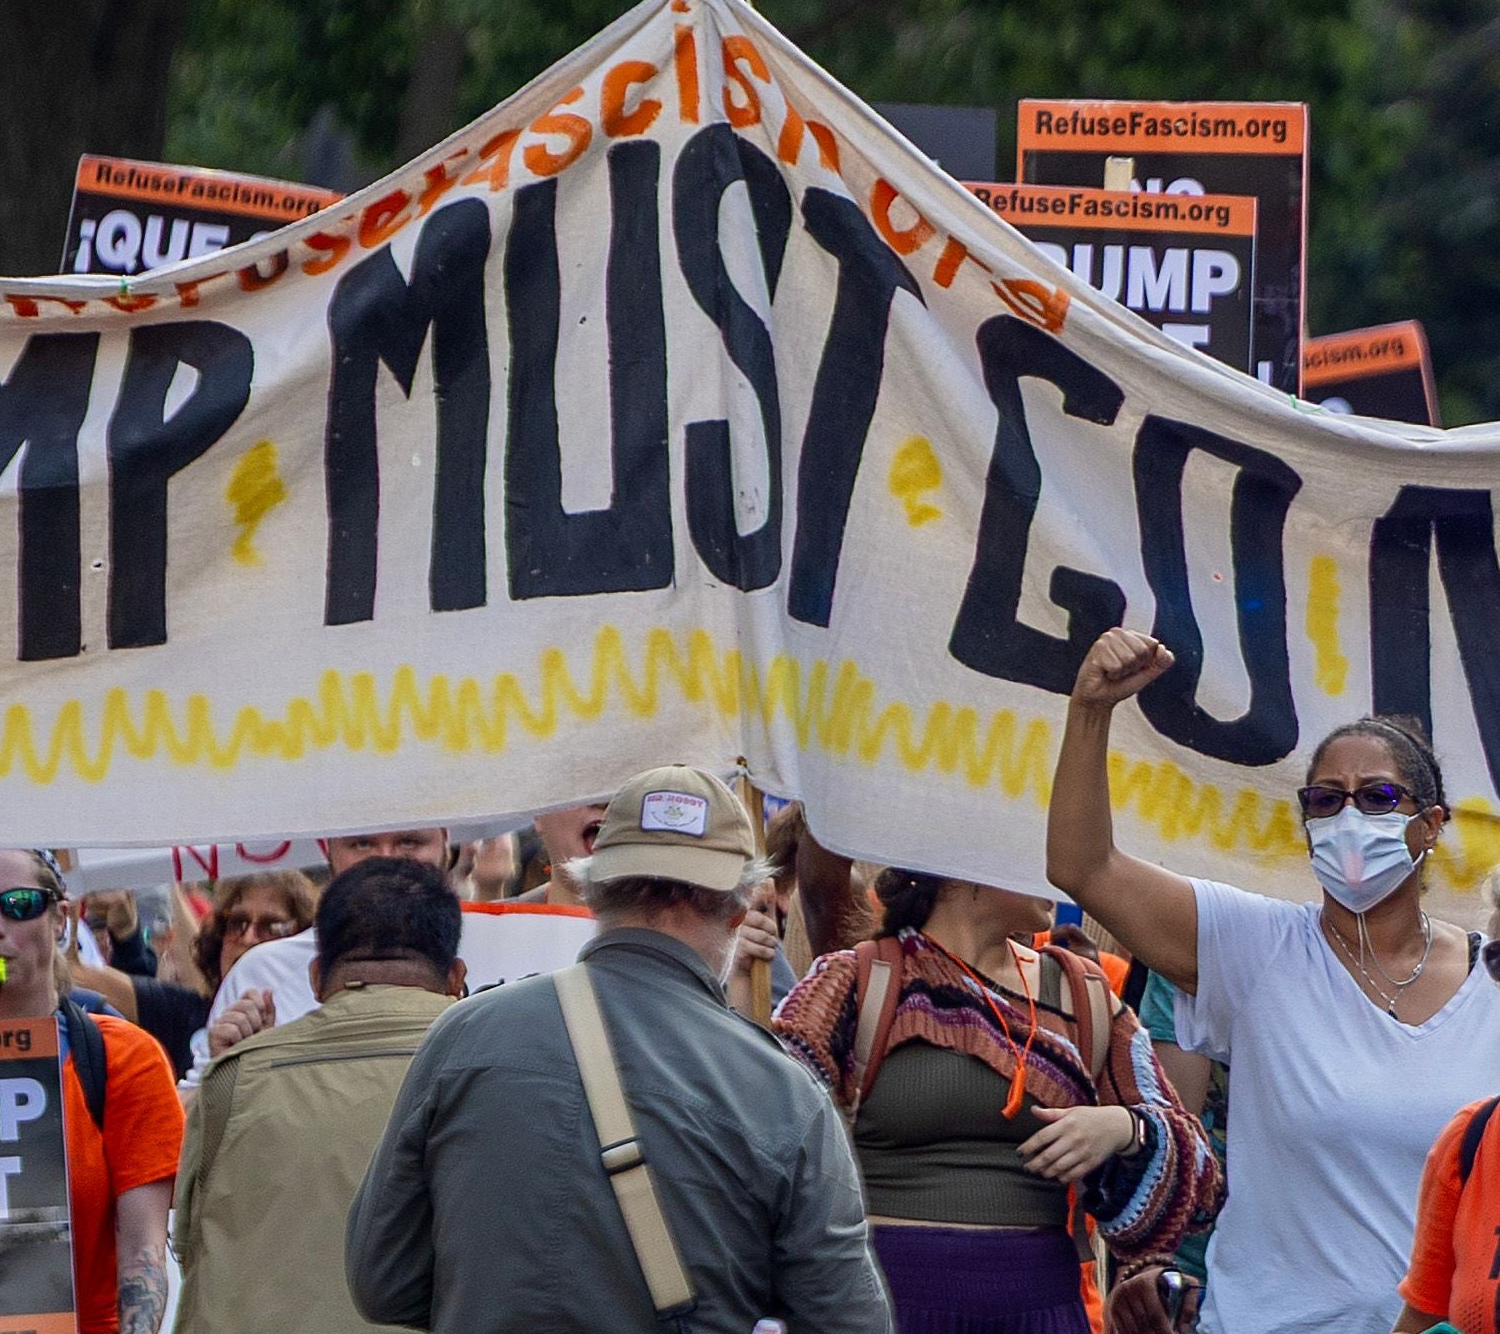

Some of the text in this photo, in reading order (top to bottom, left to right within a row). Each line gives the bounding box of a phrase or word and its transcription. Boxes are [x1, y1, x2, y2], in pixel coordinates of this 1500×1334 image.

[1034, 110, 1288, 143] RefuseFascism.org
[96, 163, 321, 213] RefuseFascism.org
[323, 122, 927, 629] MUST
[948, 313, 1303, 767] GO
